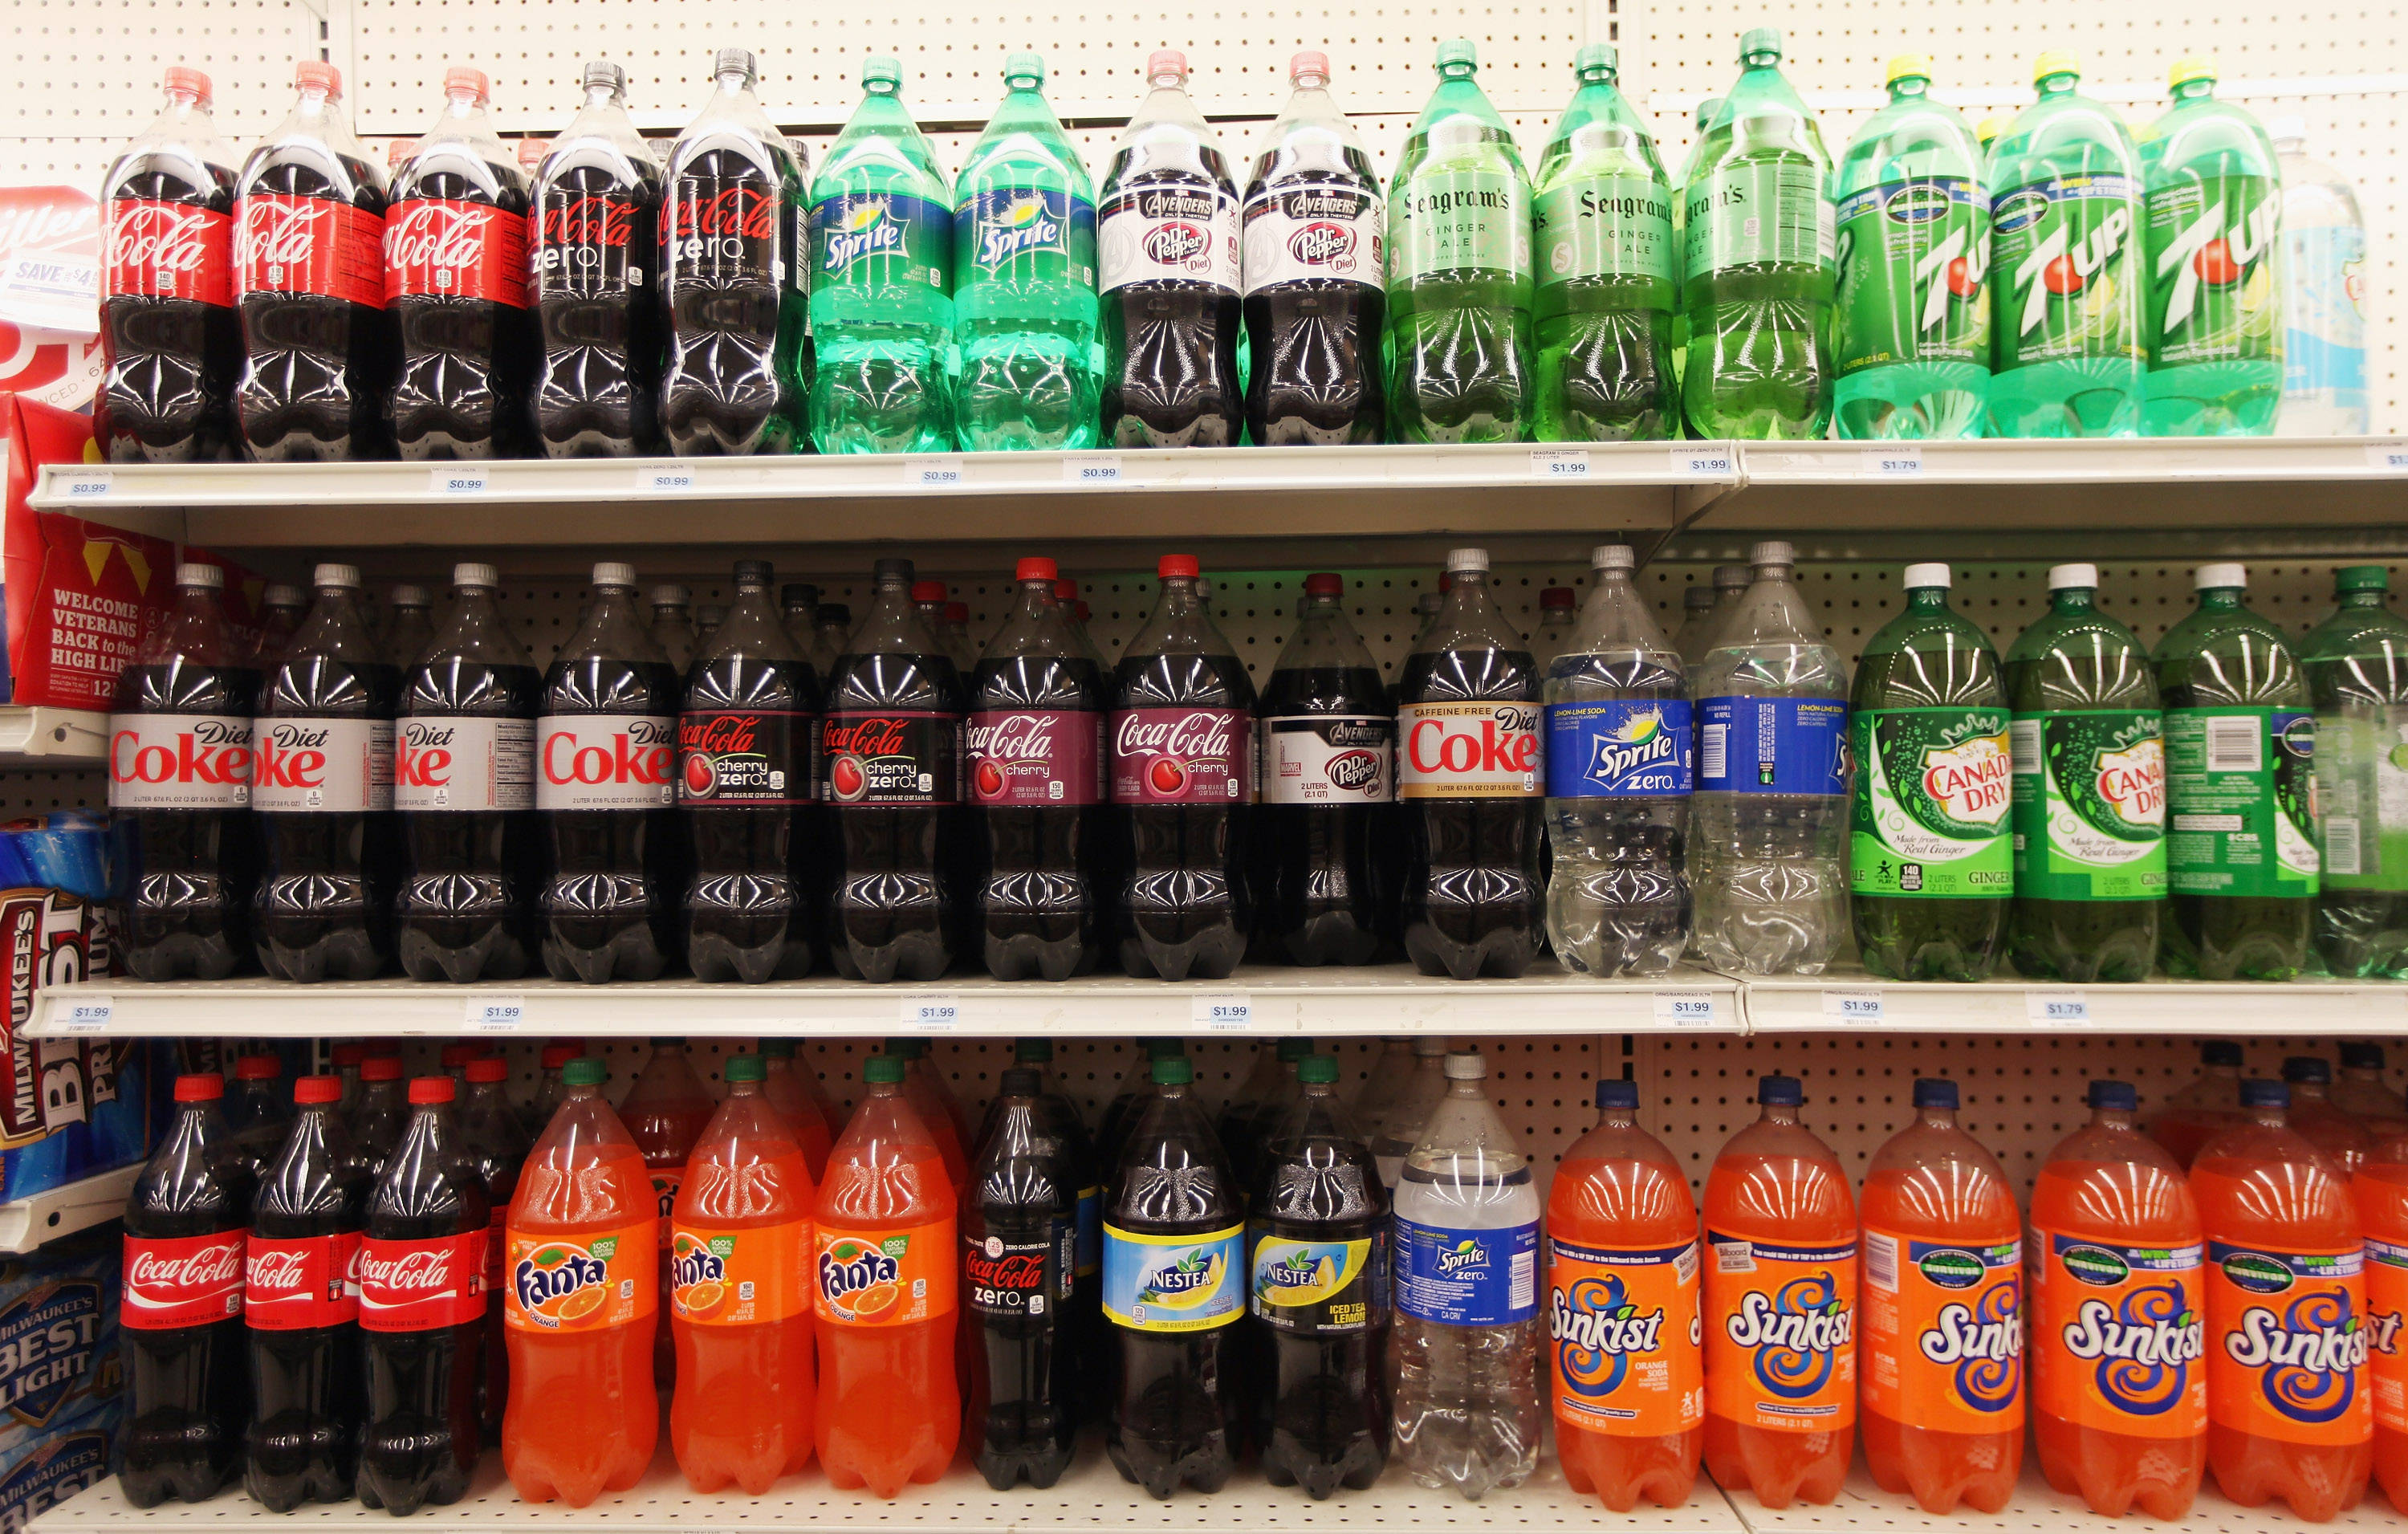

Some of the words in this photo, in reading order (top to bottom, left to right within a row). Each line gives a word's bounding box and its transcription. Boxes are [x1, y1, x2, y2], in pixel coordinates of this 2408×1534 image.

[1145, 192, 1212, 218] AVENGERS
[1291, 192, 1357, 218] AVENGERS
[1404, 187, 1509, 219] Seagram's
[0, 204, 97, 250] iller
[1169, 227, 1190, 242] Dr
[1315, 228, 1336, 242] Dr
[1426, 224, 1486, 236] GINGER
[981, 218, 1057, 264] Sprite
[1441, 238, 1470, 248] ALE
[1609, 230, 1662, 242] GINGER
[673, 238, 744, 262] zero
[825, 218, 898, 271] Sprite
[1155, 231, 1202, 260] Pepper
[1301, 231, 1348, 260] Pepper
[1625, 245, 1650, 254] ALE
[533, 247, 598, 274] zero
[1190, 258, 1208, 271] Diet
[1336, 258, 1353, 271] Diet
[16, 262, 63, 282] SAVE
[2015, 207, 2128, 337] 7UP
[1083, 468, 1117, 477] $0.99
[1552, 464, 1585, 473] $1.99
[1692, 461, 1726, 470] $1.99
[1882, 461, 1917, 470] $1.79
[656, 477, 688, 486] $0.99
[924, 471, 956, 480] $0.99
[73, 483, 106, 493] $0.99
[450, 480, 482, 489] $0.99
[53, 588, 138, 620] WELCOME
[52, 608, 137, 638] VETERANS
[51, 628, 99, 650] BACK
[103, 638, 114, 653] to
[117, 641, 136, 656] the
[51, 648, 96, 669] HIGH
[100, 656, 126, 673] LIF
[1415, 707, 1460, 717] CAFFEINE
[1554, 708, 1586, 717] LEMON-LIME
[1797, 704, 1832, 713] LEMON-LIME
[1495, 706, 1538, 731] Diet
[194, 721, 253, 744] Diet
[273, 725, 330, 747] Diet
[406, 722, 455, 747] Diet
[628, 721, 673, 744] Diet
[1117, 713, 1235, 757] Coca-Cola
[1409, 719, 1537, 773] Coke
[1596, 729, 1672, 779] Sprite
[111, 730, 250, 784] Coke
[544, 731, 673, 785] Coke
[1351, 755, 1368, 767] Dr
[717, 759, 767, 775] cherry
[866, 762, 917, 778] cherry
[1007, 764, 1049, 778] cherry
[1188, 762, 1228, 776] cherry
[1280, 763, 1301, 773] MARVEL
[1340, 759, 1377, 785] Pepper
[720, 774, 763, 786] zero
[869, 776, 912, 788] zero
[1626, 775, 1673, 789] zero
[1367, 782, 1381, 795] Diet
[1963, 779, 2007, 812] DRY
[1893, 835, 1918, 844] Made
[1919, 835, 1940, 844] from
[1904, 844, 1928, 854] Real
[1930, 844, 1966, 857] Ginger
[1904, 865, 1918, 875] 140
[75, 1007, 109, 1017] $1.99
[486, 1007, 520, 1016] $1.99
[921, 1007, 954, 1017] $1.99
[1214, 1007, 1247, 1015] $1.99
[1675, 1002, 1709, 1011] $1.99
[1844, 1001, 1878, 1011] $1.99
[2048, 1004, 2082, 1014] $1.79
[592, 1241, 616, 1250] 100%
[131, 1242, 244, 1288] Coca-Cola
[1438, 1247, 1484, 1272] Sprite
[673, 1247, 724, 1291] anta
[819, 1251, 897, 1302] Fanta
[966, 1250, 1047, 1288] Coca-Cola
[1267, 1262, 1319, 1287] NESTEA
[1455, 1272, 1484, 1280] zero
[515, 1253, 607, 1311] Fanta
[1151, 1269, 1211, 1288] NESTEA
[974, 1287, 1020, 1306] zero
[830, 1304, 855, 1321] ORANGE
[1330, 1305, 1350, 1315] ICED
[1351, 1303, 1366, 1312] TEA
[530, 1312, 559, 1328] ORANGE
[1334, 1312, 1366, 1324] LEMON
[1550, 1288, 1663, 1352] Sunkist
[1728, 1292, 1853, 1353] Sunkist
[0, 1312, 100, 1381] BEST
[1635, 1360, 1668, 1369] ORANGE
[0, 1349, 90, 1410] LIGHT
[1647, 1369, 1668, 1377] SODA
